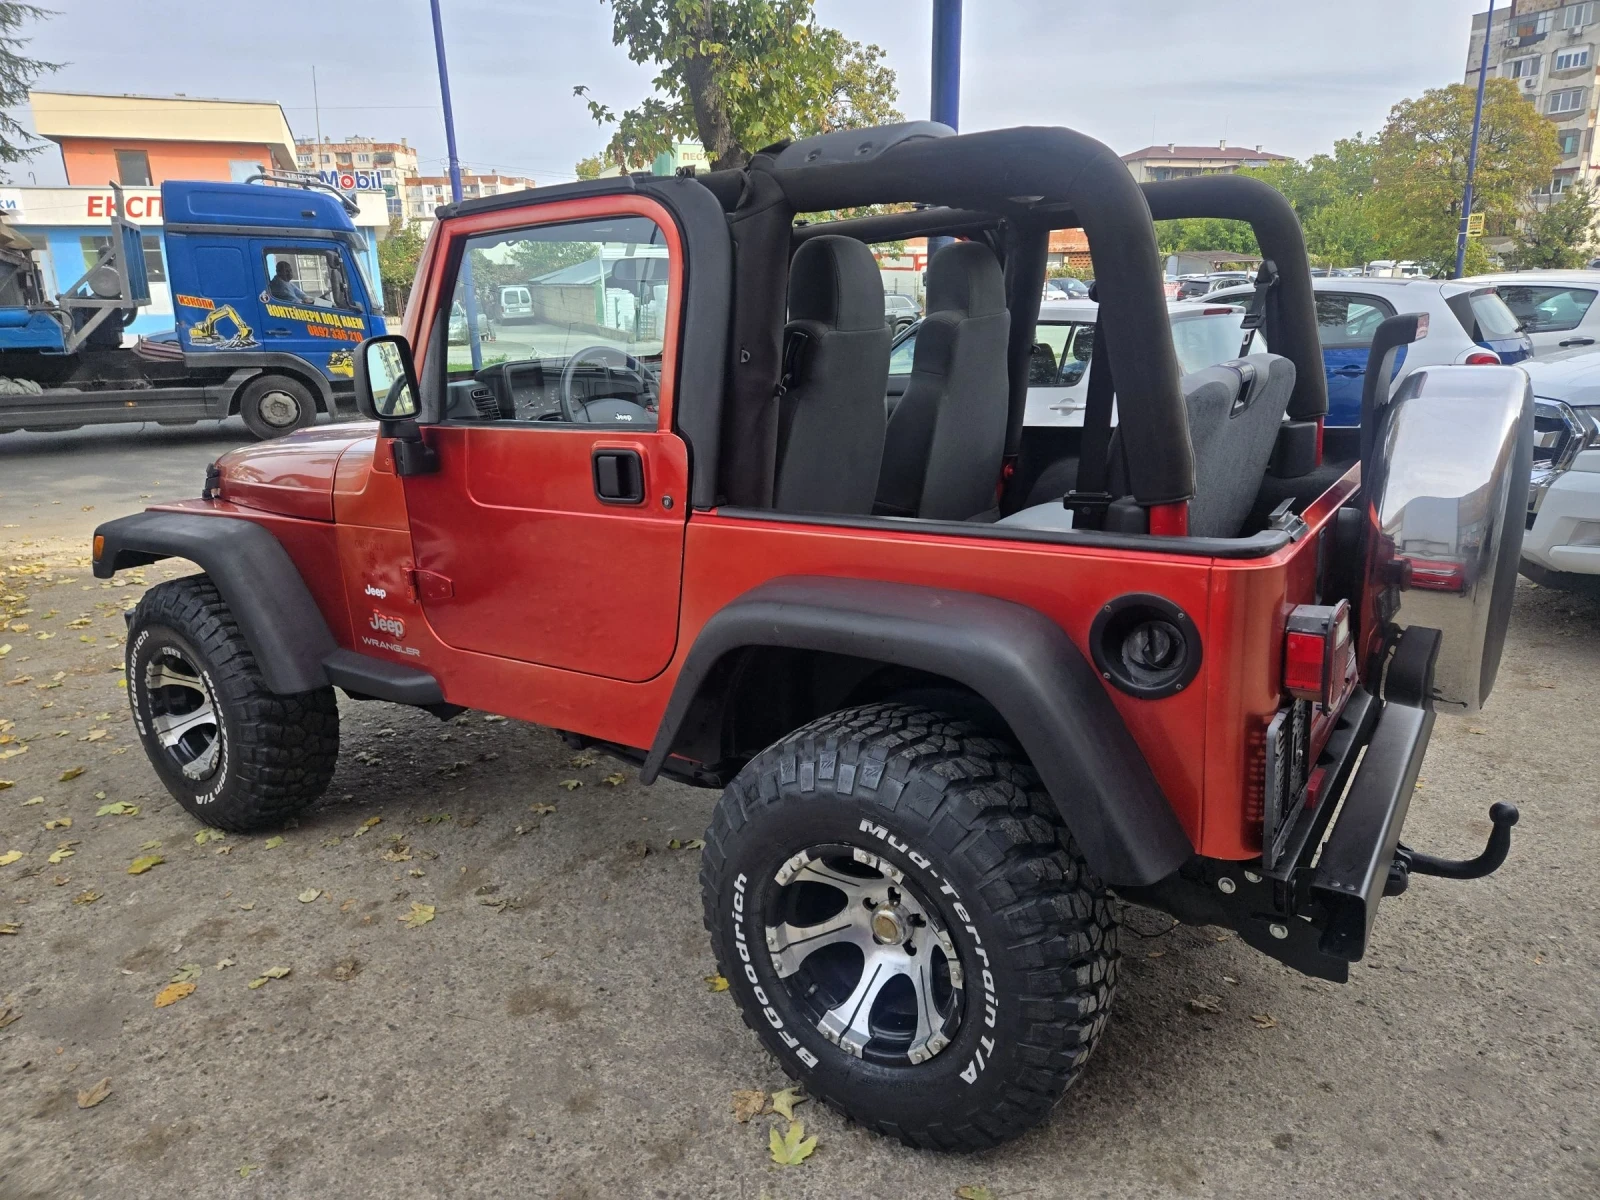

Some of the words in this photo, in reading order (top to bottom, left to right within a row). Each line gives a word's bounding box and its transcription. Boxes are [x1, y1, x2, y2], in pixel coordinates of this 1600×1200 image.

[682, 152, 707, 161] ПЕС
[319, 170, 383, 190] Mobil
[265, 303, 322, 323] КОНТЕЙНЕРИ
[320, 311, 342, 329] ПОД
[340, 315, 365, 330] НАЕМ
[307, 324, 331, 338] 0892
[615, 412, 633, 422] Jeep
[364, 584, 387, 599] Jeep
[369, 609, 405, 638] Jeep
[361, 636, 421, 657] WRANGLER
[130, 630, 150, 735] BFGoodrich
[858, 817, 1000, 1029] Mud-Terrain
[959, 1034, 996, 1085] T/A
[731, 872, 819, 1069] BFGoodrich
